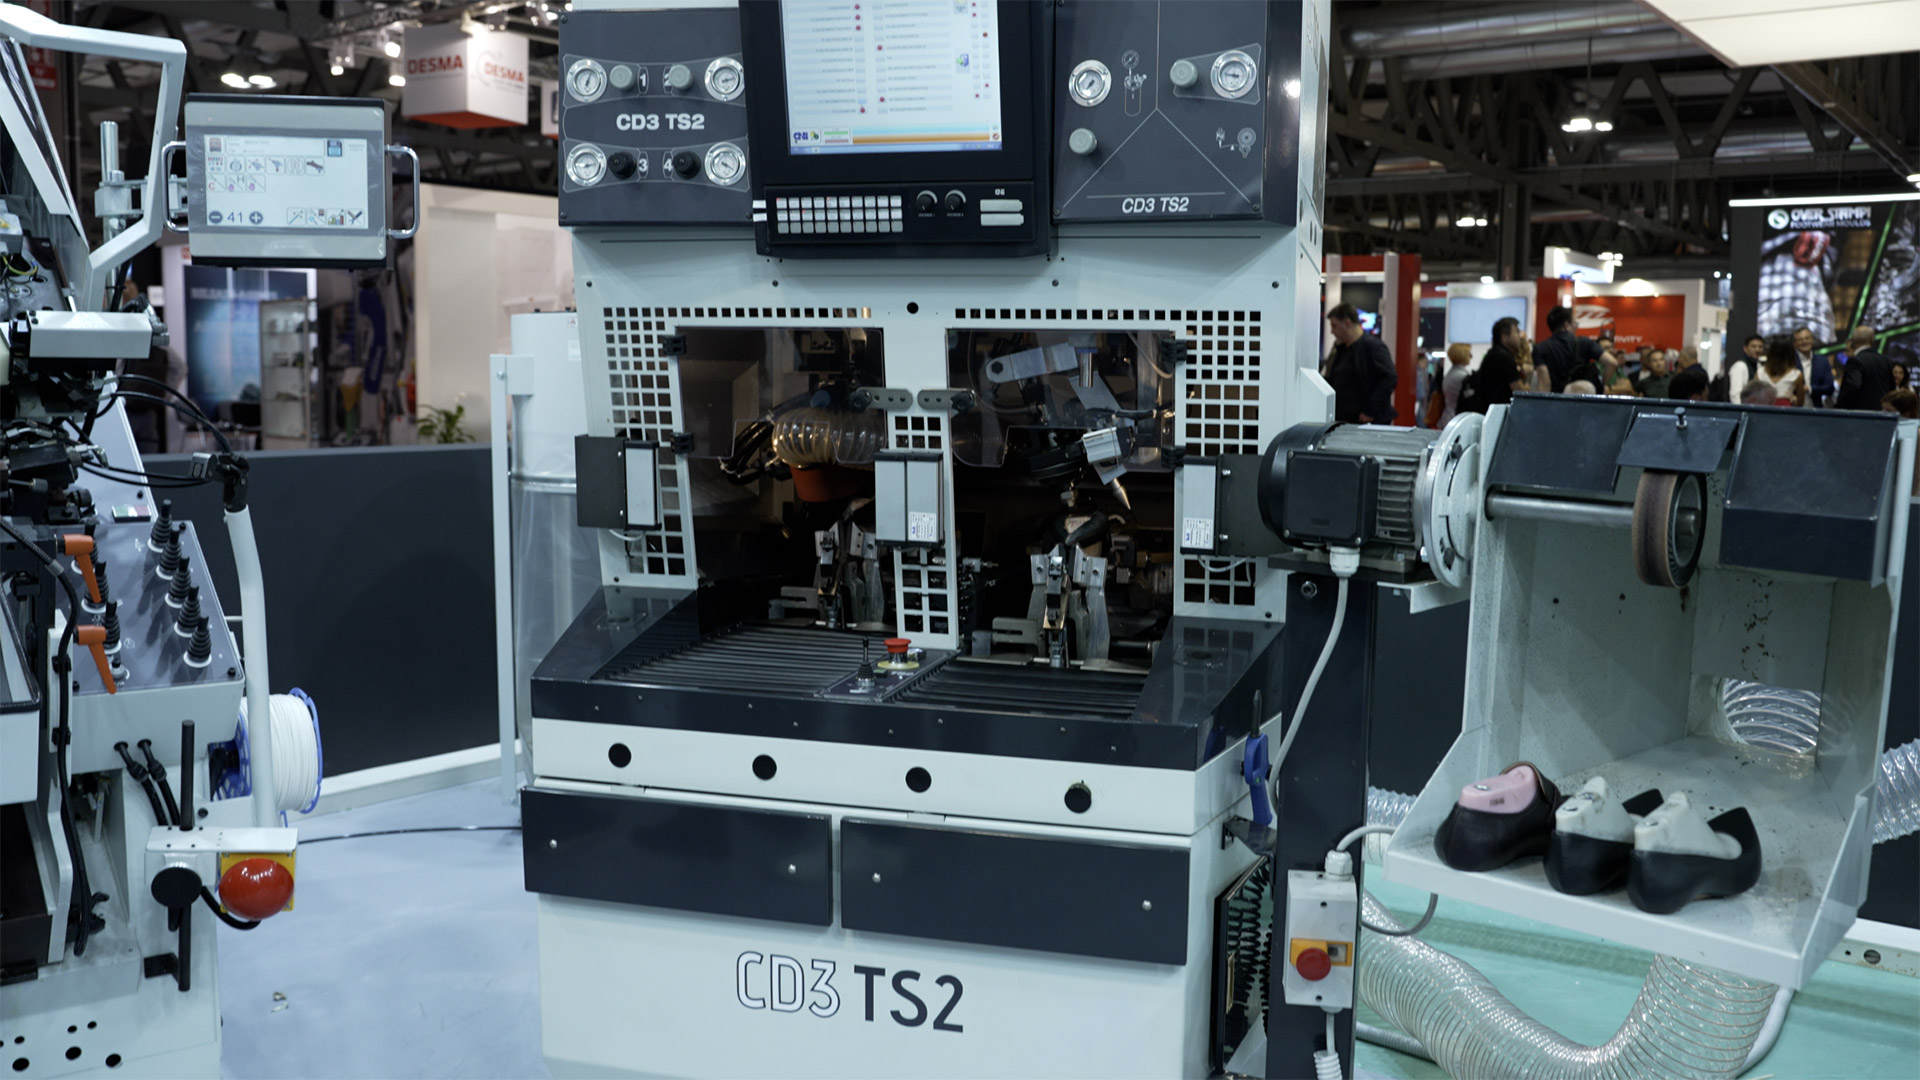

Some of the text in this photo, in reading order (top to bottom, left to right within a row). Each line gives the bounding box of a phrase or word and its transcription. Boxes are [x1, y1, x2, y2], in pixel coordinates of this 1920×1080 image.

[407, 55, 464, 75] DESMA
[484, 61, 525, 82] DESMA
[639, 73, 646, 87] 1
[616, 114, 705, 131] CD3 TS2
[639, 158, 648, 172] 3
[663, 158, 673, 172] 4
[1122, 197, 1190, 214] CD3 TS2
[227, 212, 243, 223] 41
[1791, 208, 1824, 221] OVER
[736, 951, 964, 1033] CD3 TS2
